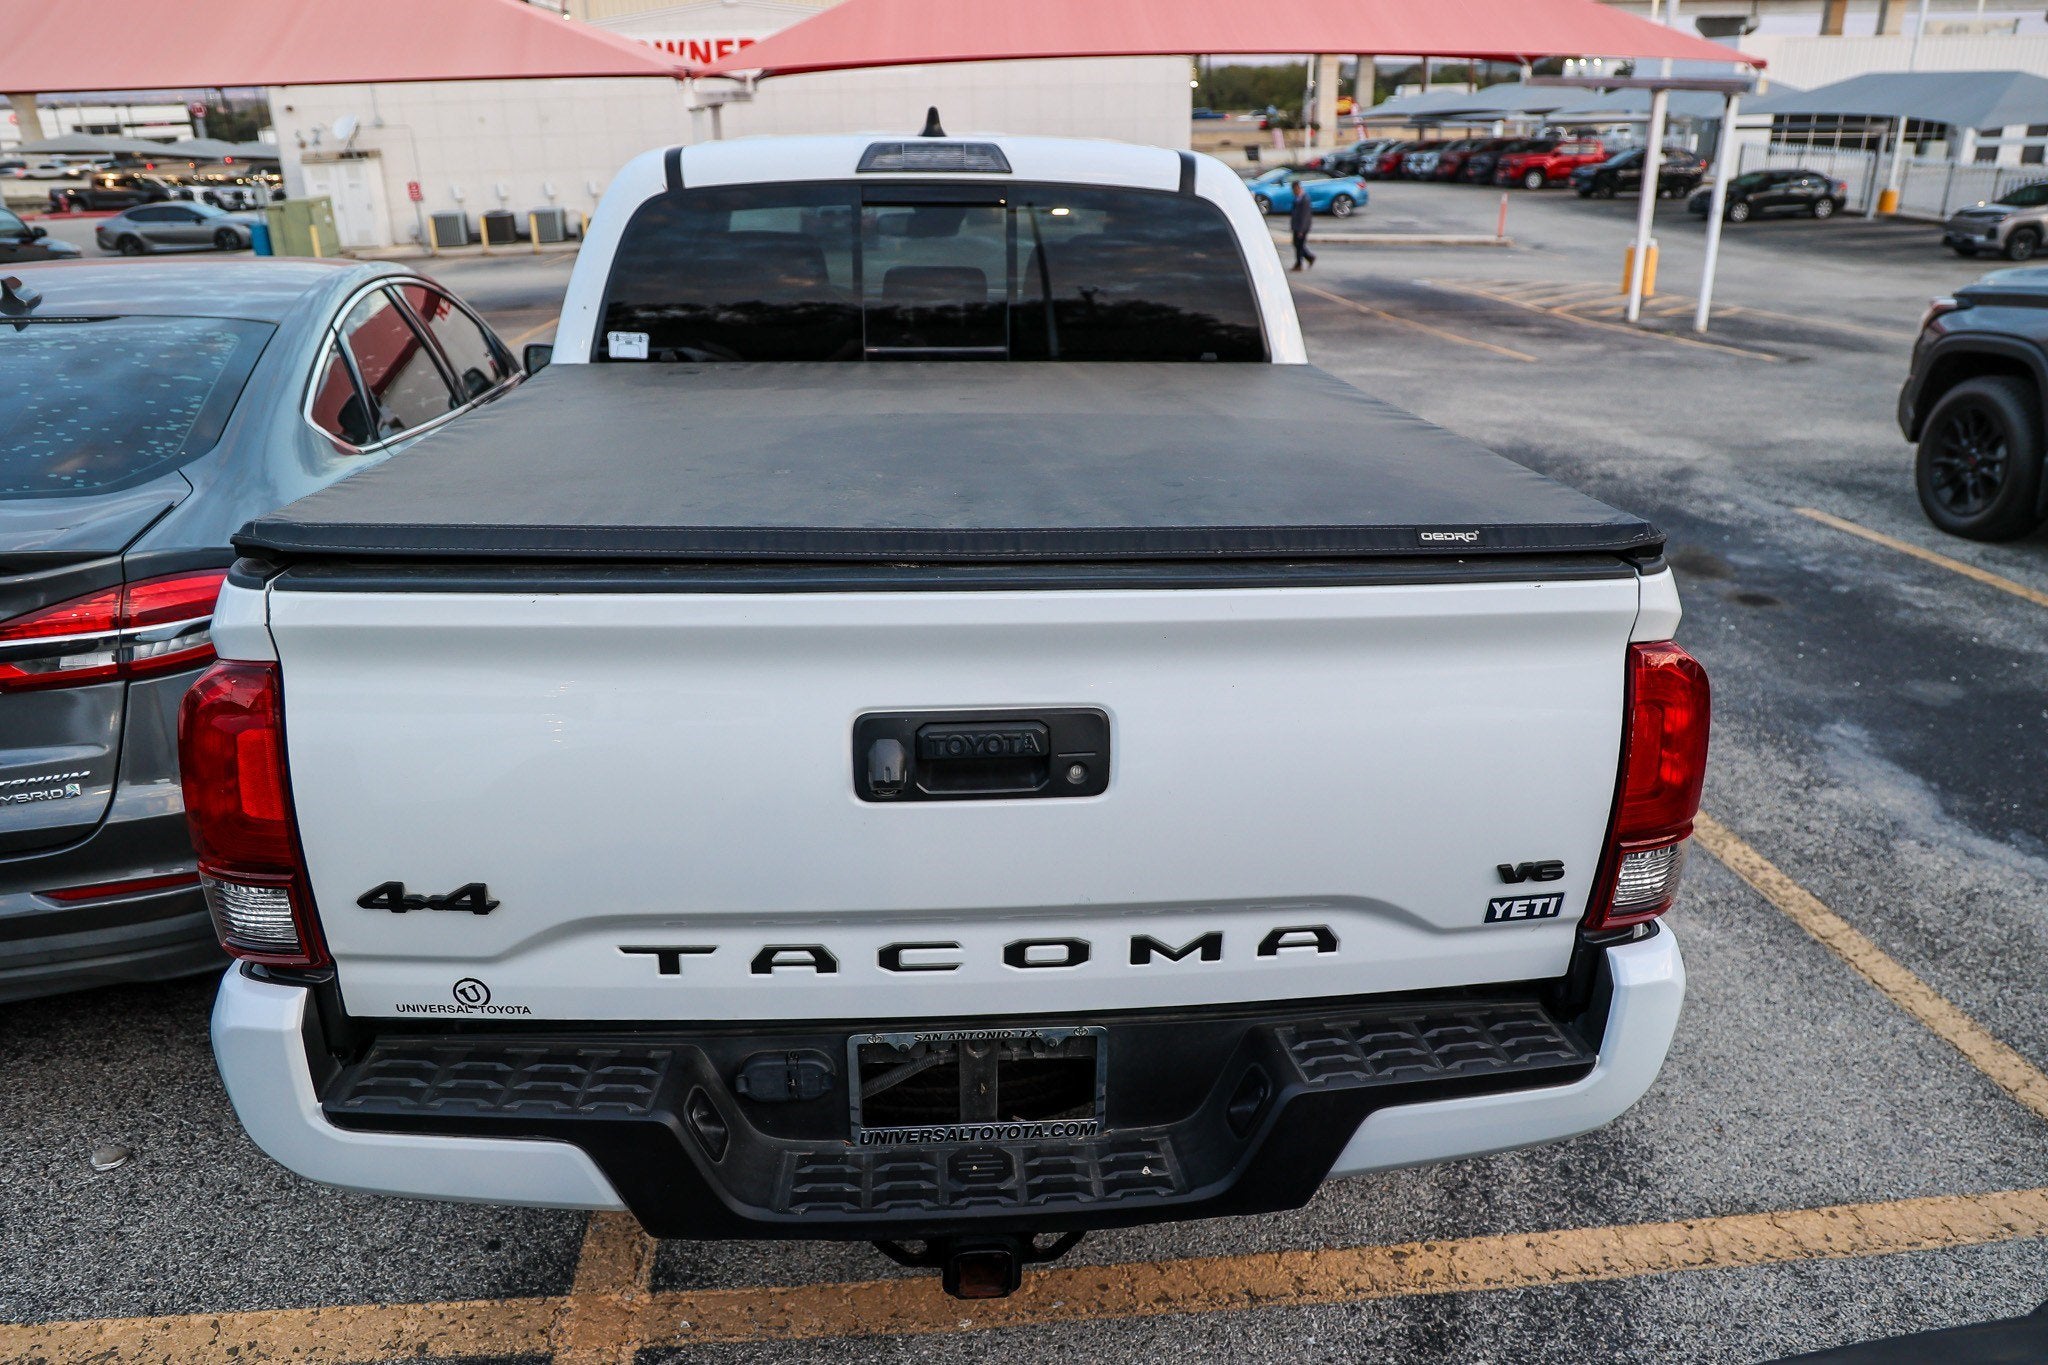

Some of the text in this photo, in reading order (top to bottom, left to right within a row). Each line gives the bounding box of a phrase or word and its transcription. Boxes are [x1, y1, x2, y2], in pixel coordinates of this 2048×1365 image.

[928, 733, 1041, 756] TOYOTA
[1496, 859, 1565, 884] V6
[356, 880, 501, 916] 4x4
[1491, 896, 1558, 919] YETI
[617, 925, 1342, 977] TACOMA
[395, 1003, 532, 1015] UNIVERSAL TOYOTA
[913, 1032, 943, 1042] SAN
[858, 1122, 1099, 1147] UNIVERSALTOYOTA.COM
